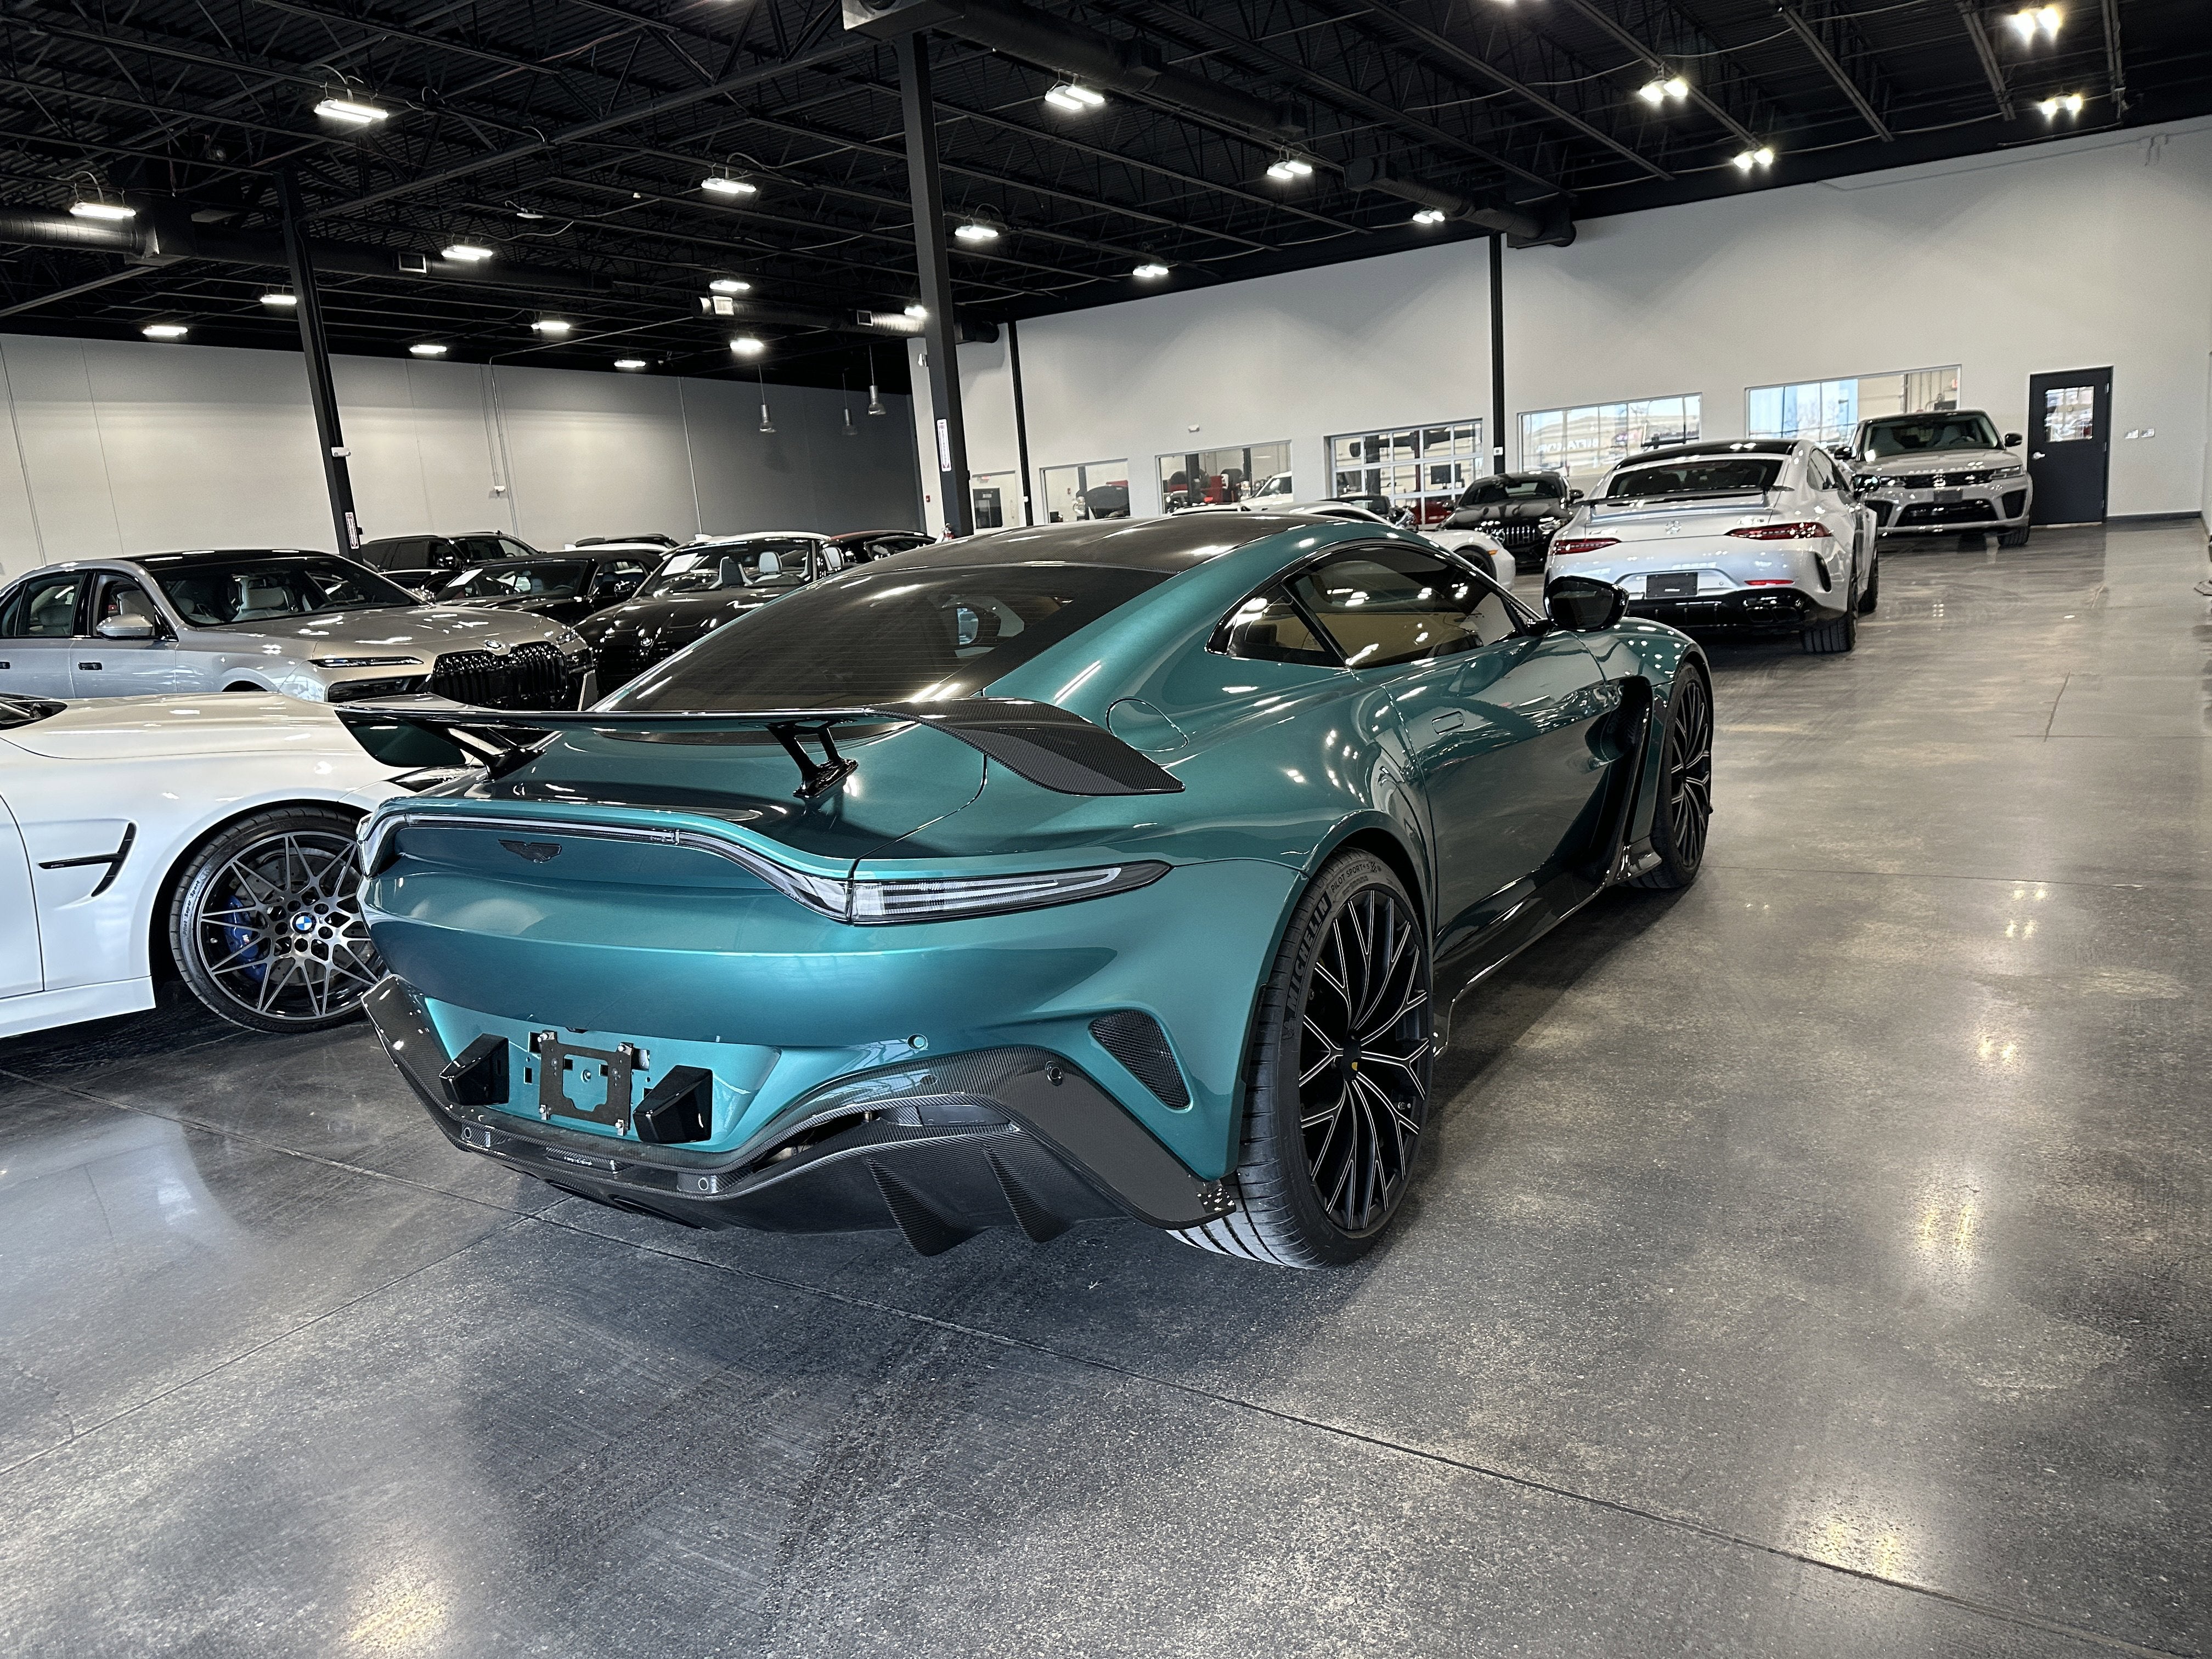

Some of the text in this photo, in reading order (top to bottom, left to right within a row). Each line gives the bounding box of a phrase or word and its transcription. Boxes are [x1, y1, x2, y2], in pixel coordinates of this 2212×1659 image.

[190, 881, 200, 898] Sport
[1331, 873, 1345, 892] PILOT
[1346, 864, 1363, 878] SPORT
[1287, 896, 1328, 1012] MICHELIN
